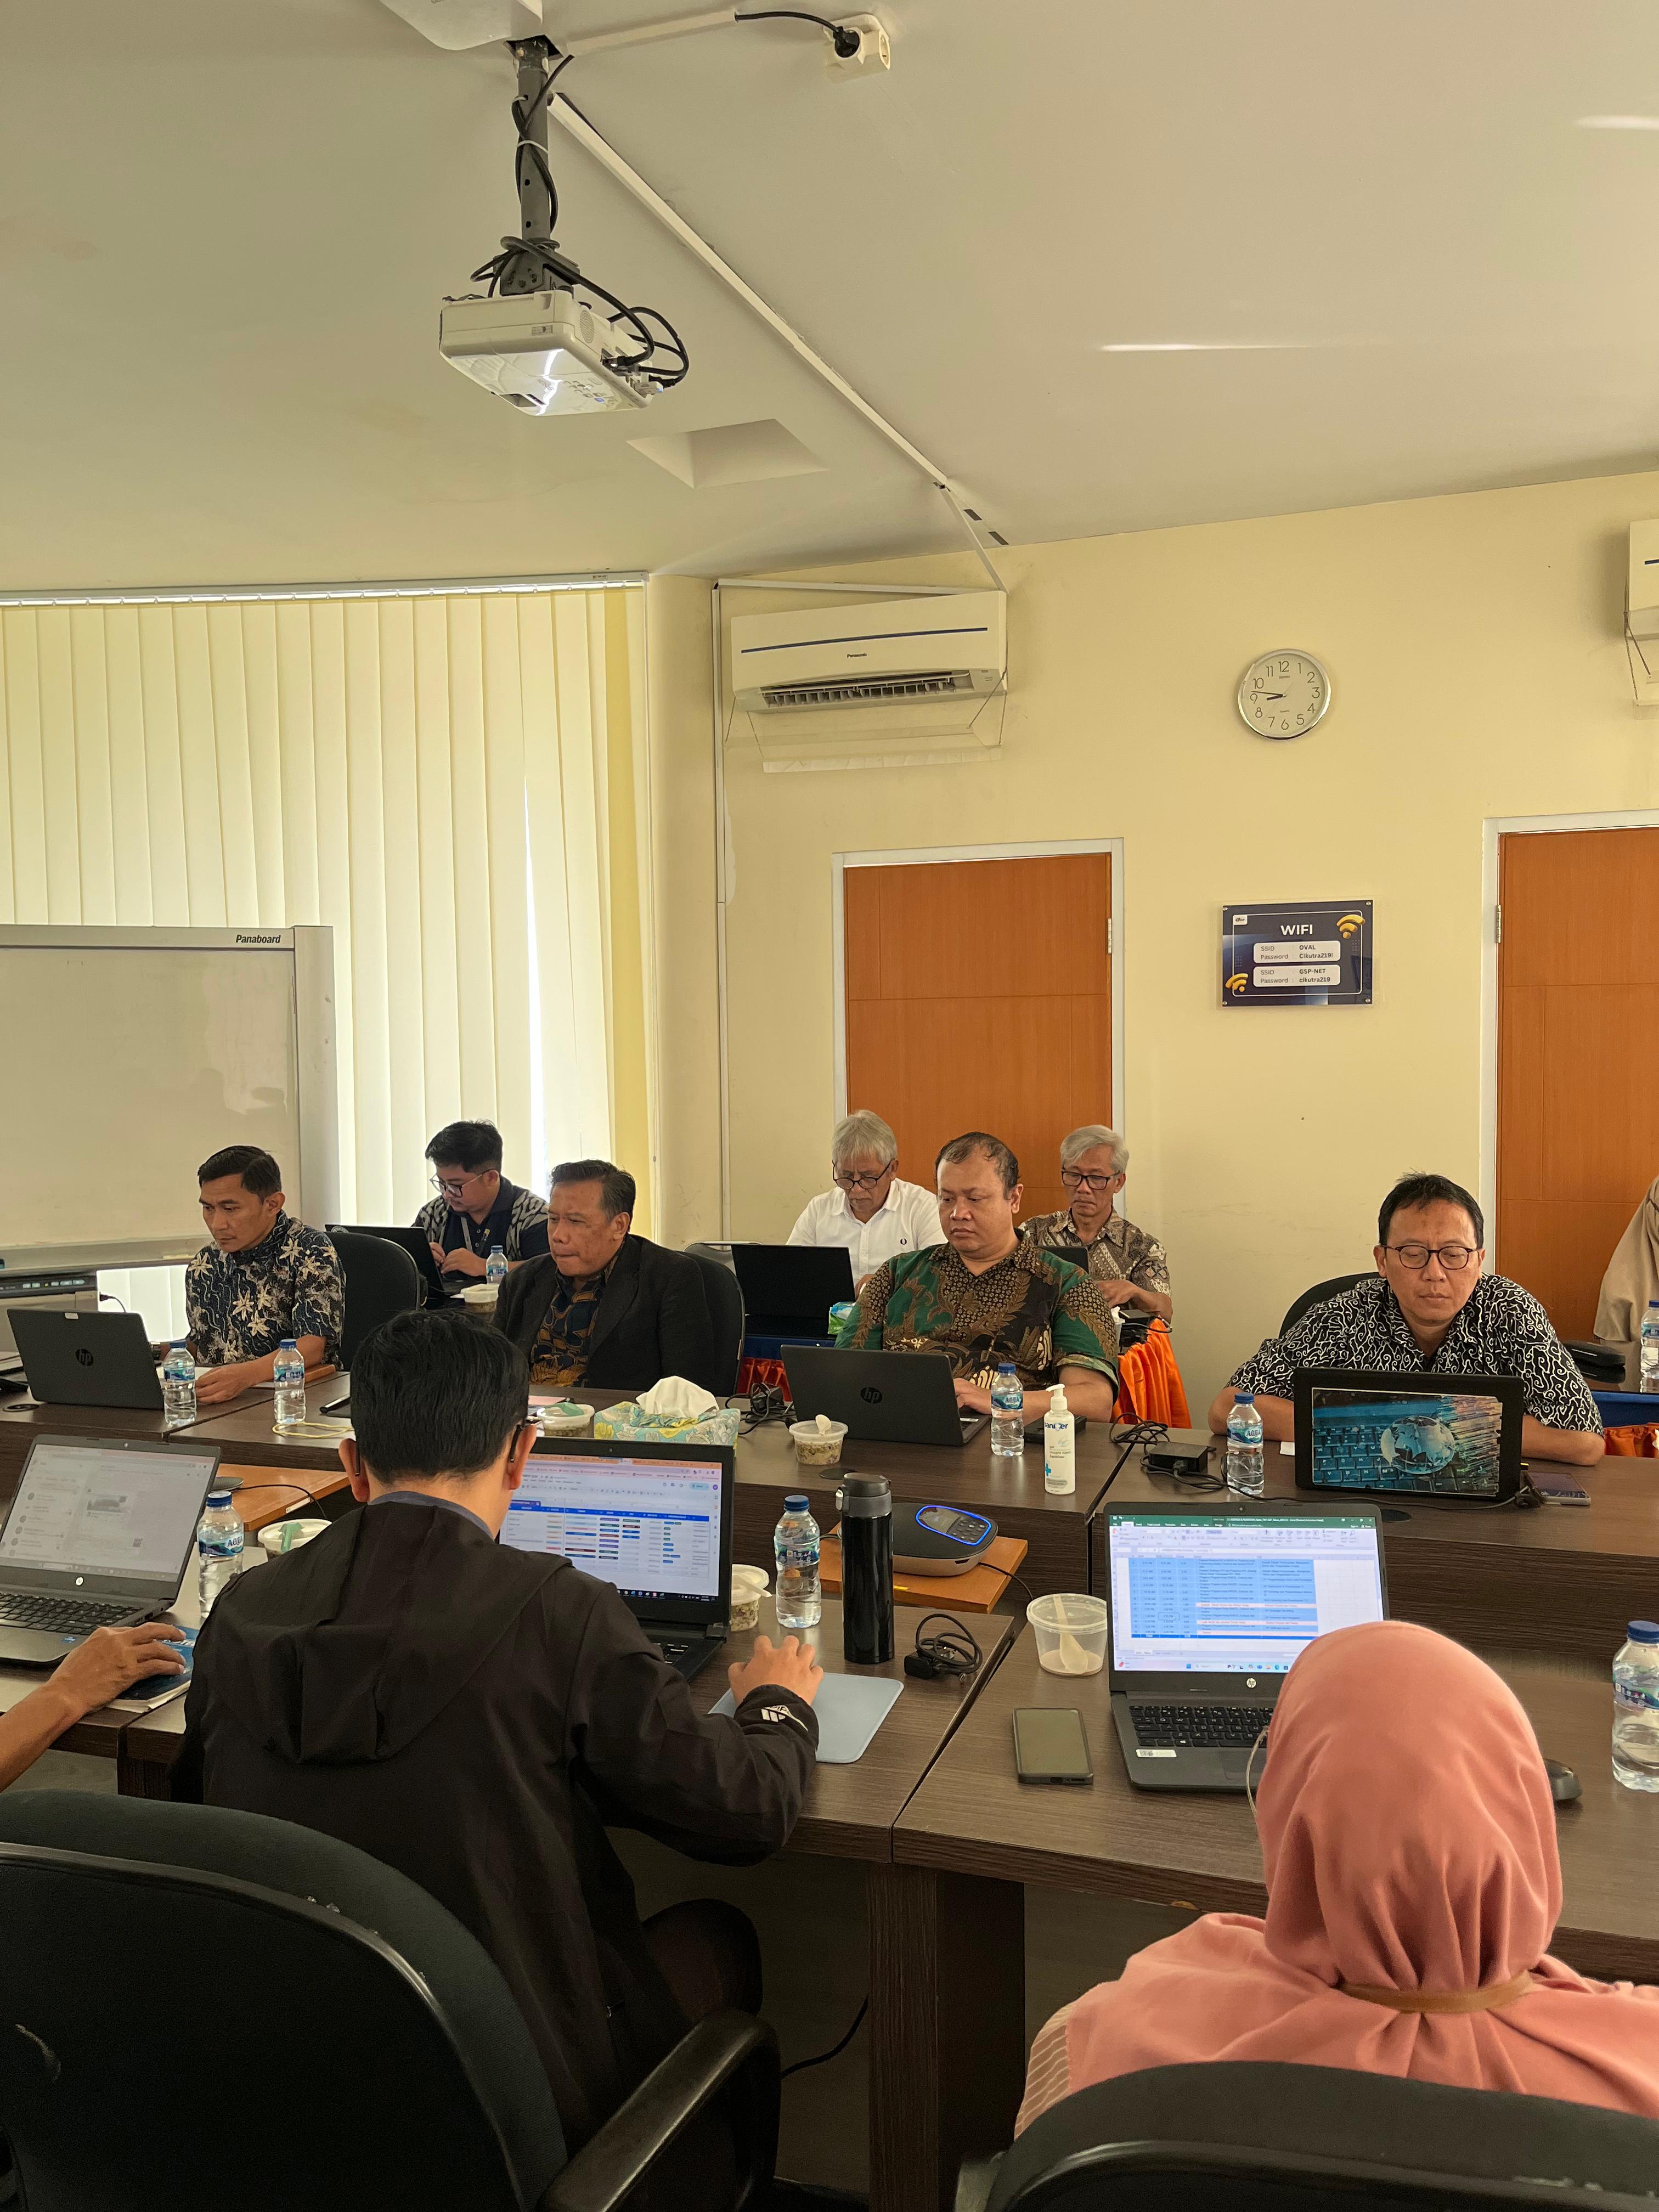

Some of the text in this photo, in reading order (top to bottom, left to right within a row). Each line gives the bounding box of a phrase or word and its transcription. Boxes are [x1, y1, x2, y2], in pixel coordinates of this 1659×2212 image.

[1266, 665, 1273, 678] 11
[1278, 661, 1289, 673] 12
[1297, 662, 1301, 674] 1
[1253, 678, 1264, 690] 10
[1307, 672, 1315, 684] 2
[1250, 693, 1258, 704] 9
[1312, 687, 1320, 699] 3
[1255, 707, 1263, 718] 8
[1307, 703, 1316, 714] 4
[1268, 716, 1276, 728] 7
[1281, 719, 1289, 730] 6
[1296, 714, 1305, 726] 5
[1280, 924, 1313, 935] WIFI
[236, 934, 281, 944] Panaboard
[77, 1349, 92, 1365] hp
[863, 1387, 881, 1404] hp
[1248, 1678, 1255, 1687] hp
